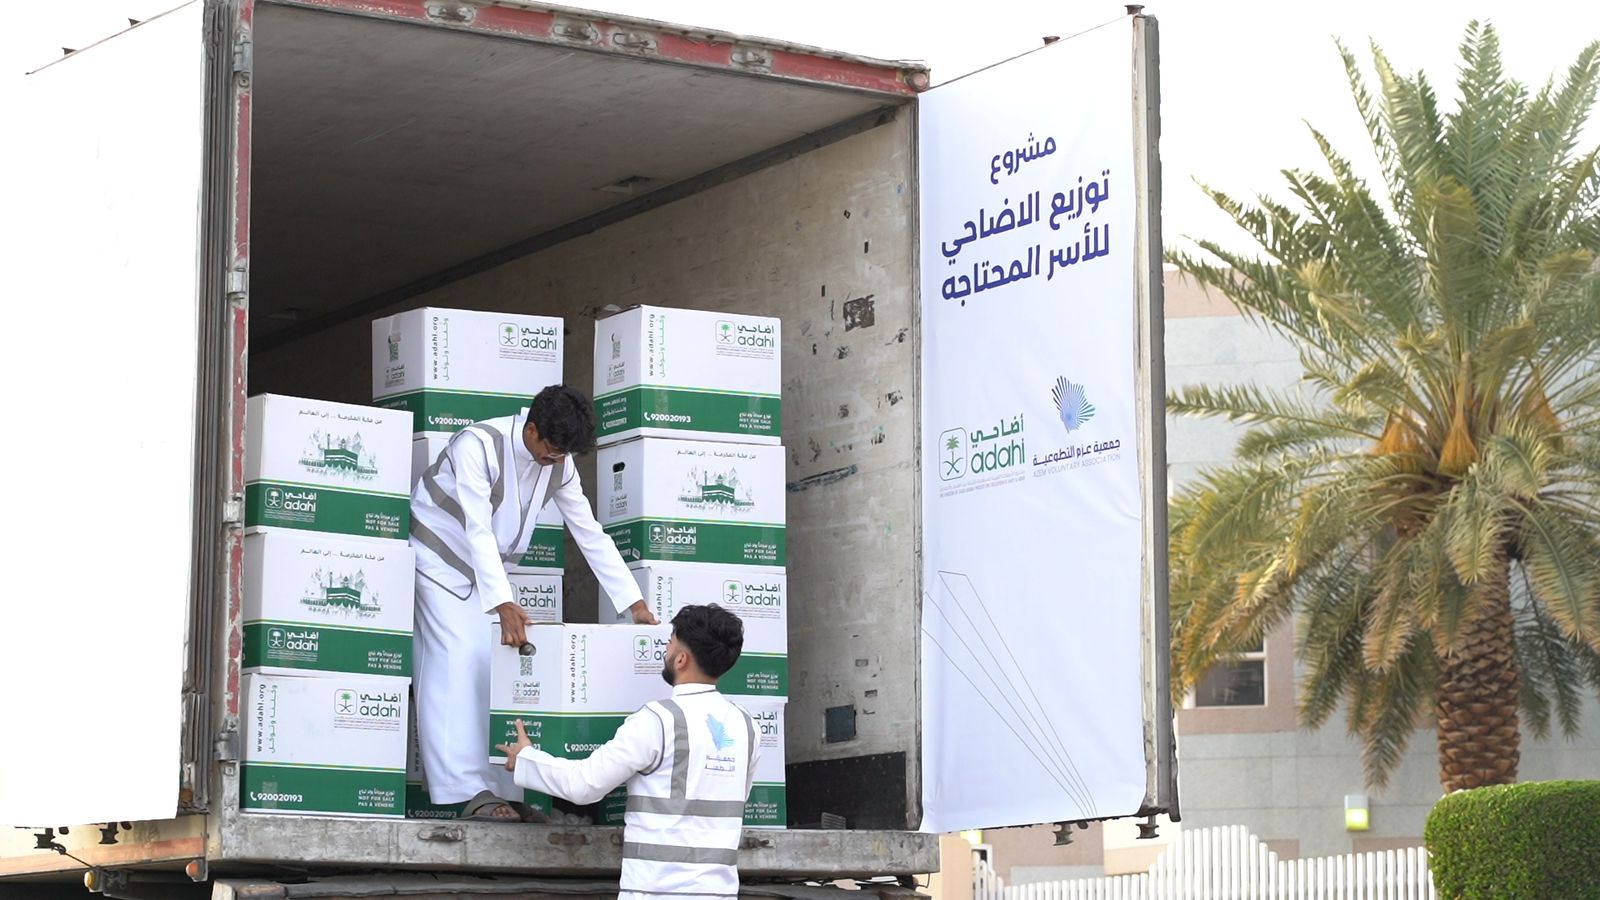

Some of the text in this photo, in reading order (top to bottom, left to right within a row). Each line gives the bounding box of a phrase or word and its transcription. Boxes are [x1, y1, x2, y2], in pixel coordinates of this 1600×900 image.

[990, 132, 1057, 185] مشروع
[941, 169, 1110, 266] توزيع الاضاحي
[941, 222, 1110, 307] للأسر المحتاجه
[520, 337, 557, 350] adahi
[738, 335, 774, 348] adahi
[651, 413, 691, 422] 920020193
[971, 438, 1025, 473] adahi
[1076, 444, 1092, 459] عزم
[284, 500, 316, 512] adahi
[667, 534, 697, 544] adahi
[518, 595, 556, 609] adahi
[744, 593, 781, 606] adahi
[286, 639, 318, 651] adahi
[359, 704, 401, 718] adahi
[257, 793, 303, 803] 920020193
